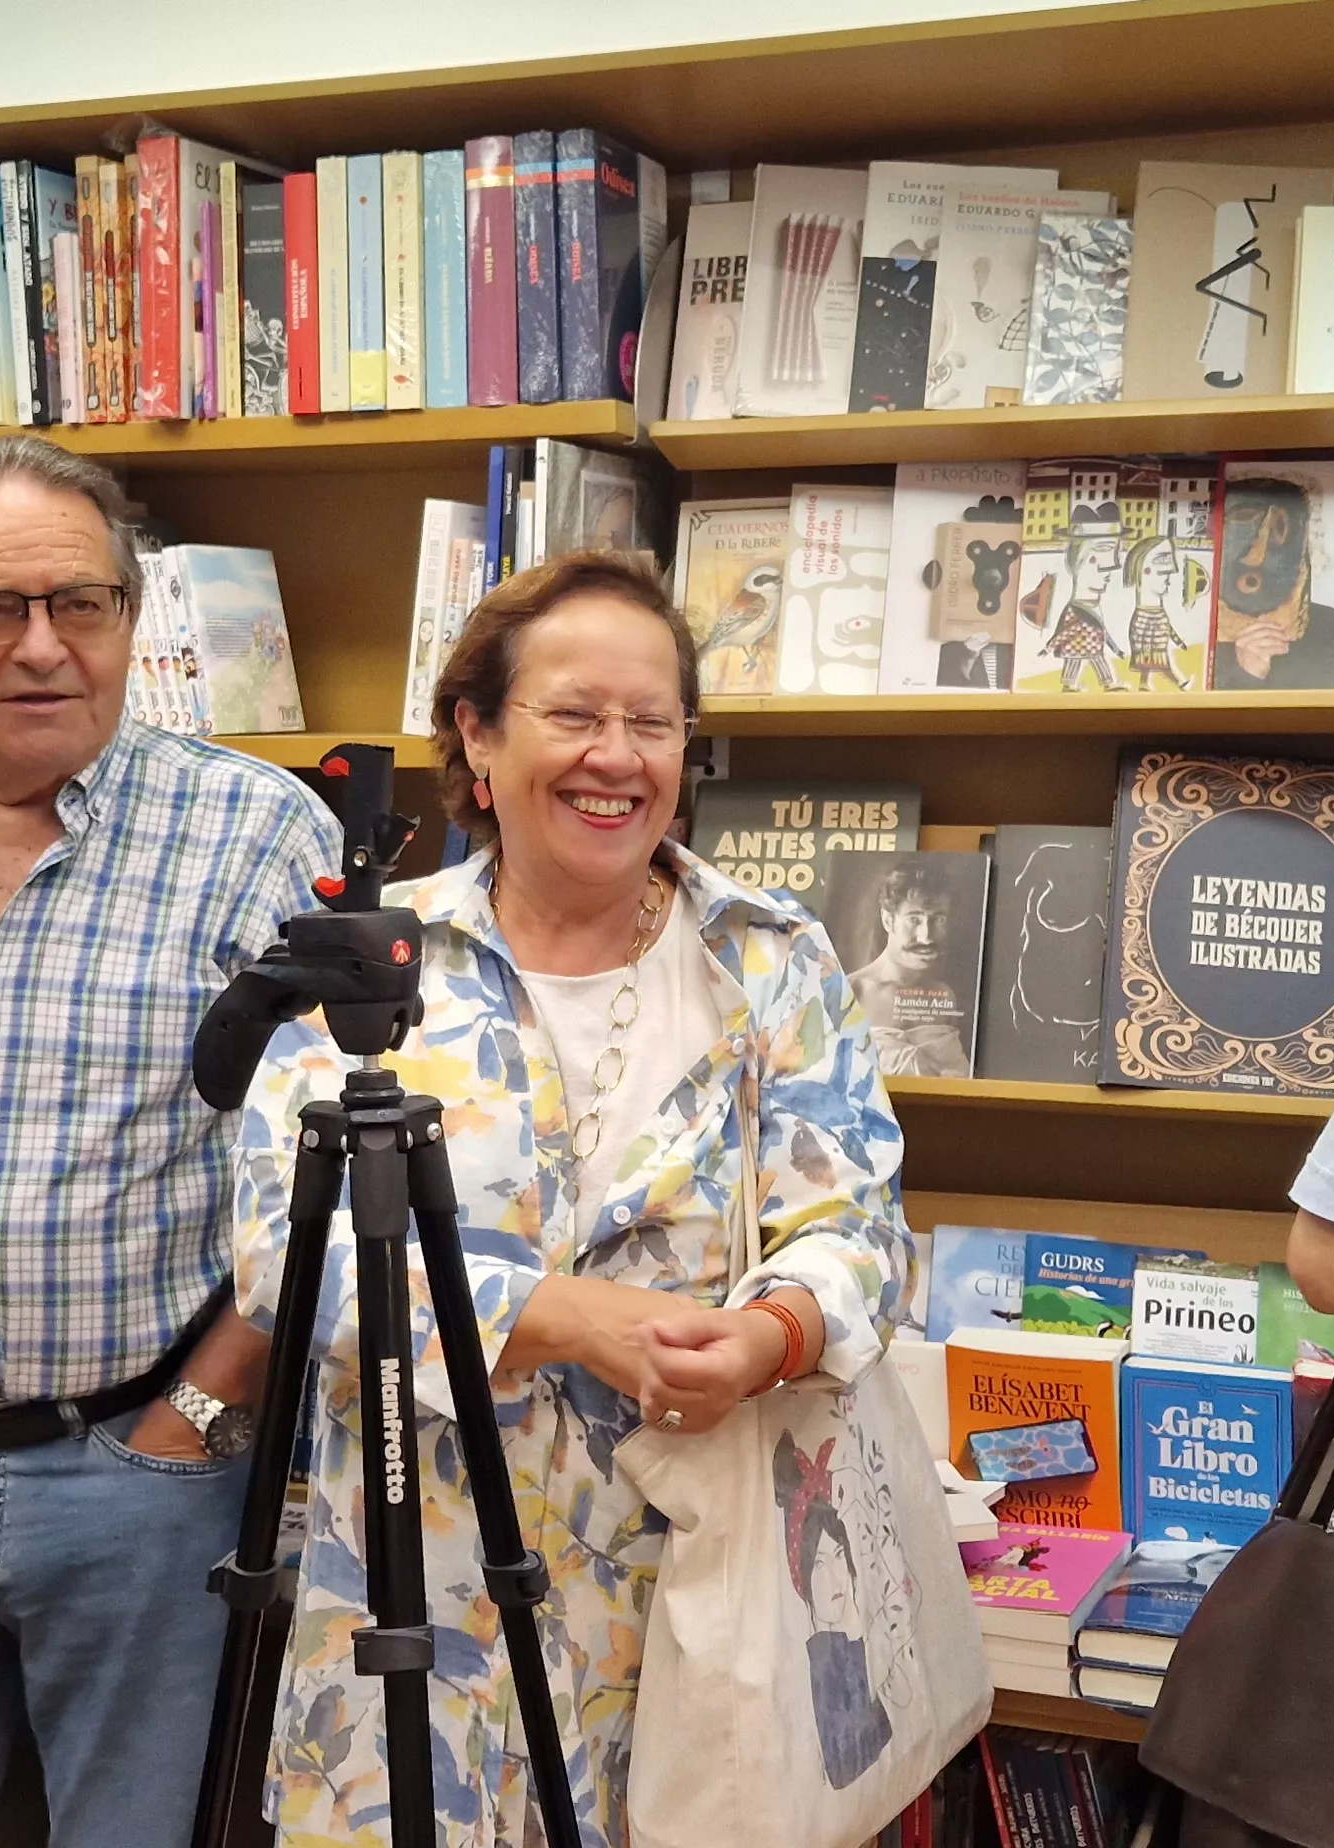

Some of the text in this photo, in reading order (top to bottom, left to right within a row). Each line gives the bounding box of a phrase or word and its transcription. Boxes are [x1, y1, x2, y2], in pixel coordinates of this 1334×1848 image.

[957, 203, 1022, 218] EDUARDO
[692, 255, 749, 280] LIBR
[690, 277, 746, 307] PRE
[707, 520, 789, 536] CUADERNOS
[802, 495, 817, 574] enciclopedia
[827, 508, 843, 576] los sonidos
[815, 520, 828, 575] visual de
[952, 526, 964, 568] FERRER
[771, 794, 899, 829] TÚ ERES
[713, 830, 896, 861] ANTES QUE
[717, 862, 815, 892] TODO
[1191, 874, 1326, 914] LEYENDAS
[1190, 908, 1324, 946] DE BÉCQUER
[1189, 940, 1322, 975] ILUSTRADAS
[894, 995, 955, 1009] Ramón Acín
[1038, 1267, 1117, 1286] Historias de una
[1040, 1251, 1105, 1273] GUDRS
[1146, 1275, 1227, 1298] Vida salvaje
[1202, 1295, 1234, 1308] de los
[1144, 1298, 1256, 1335] Pirineo
[972, 1372, 1084, 1403] ELÍSABET
[968, 1392, 1092, 1422] BENAVENT
[1198, 1400, 1214, 1416] El
[378, 1357, 406, 1505] Manfrotto
[1162, 1405, 1255, 1445] Gran
[1158, 1436, 1258, 1477] Libro
[1148, 1475, 1271, 1511] Bicicletas
[1025, 1527, 1112, 1542] BALLARÍN
